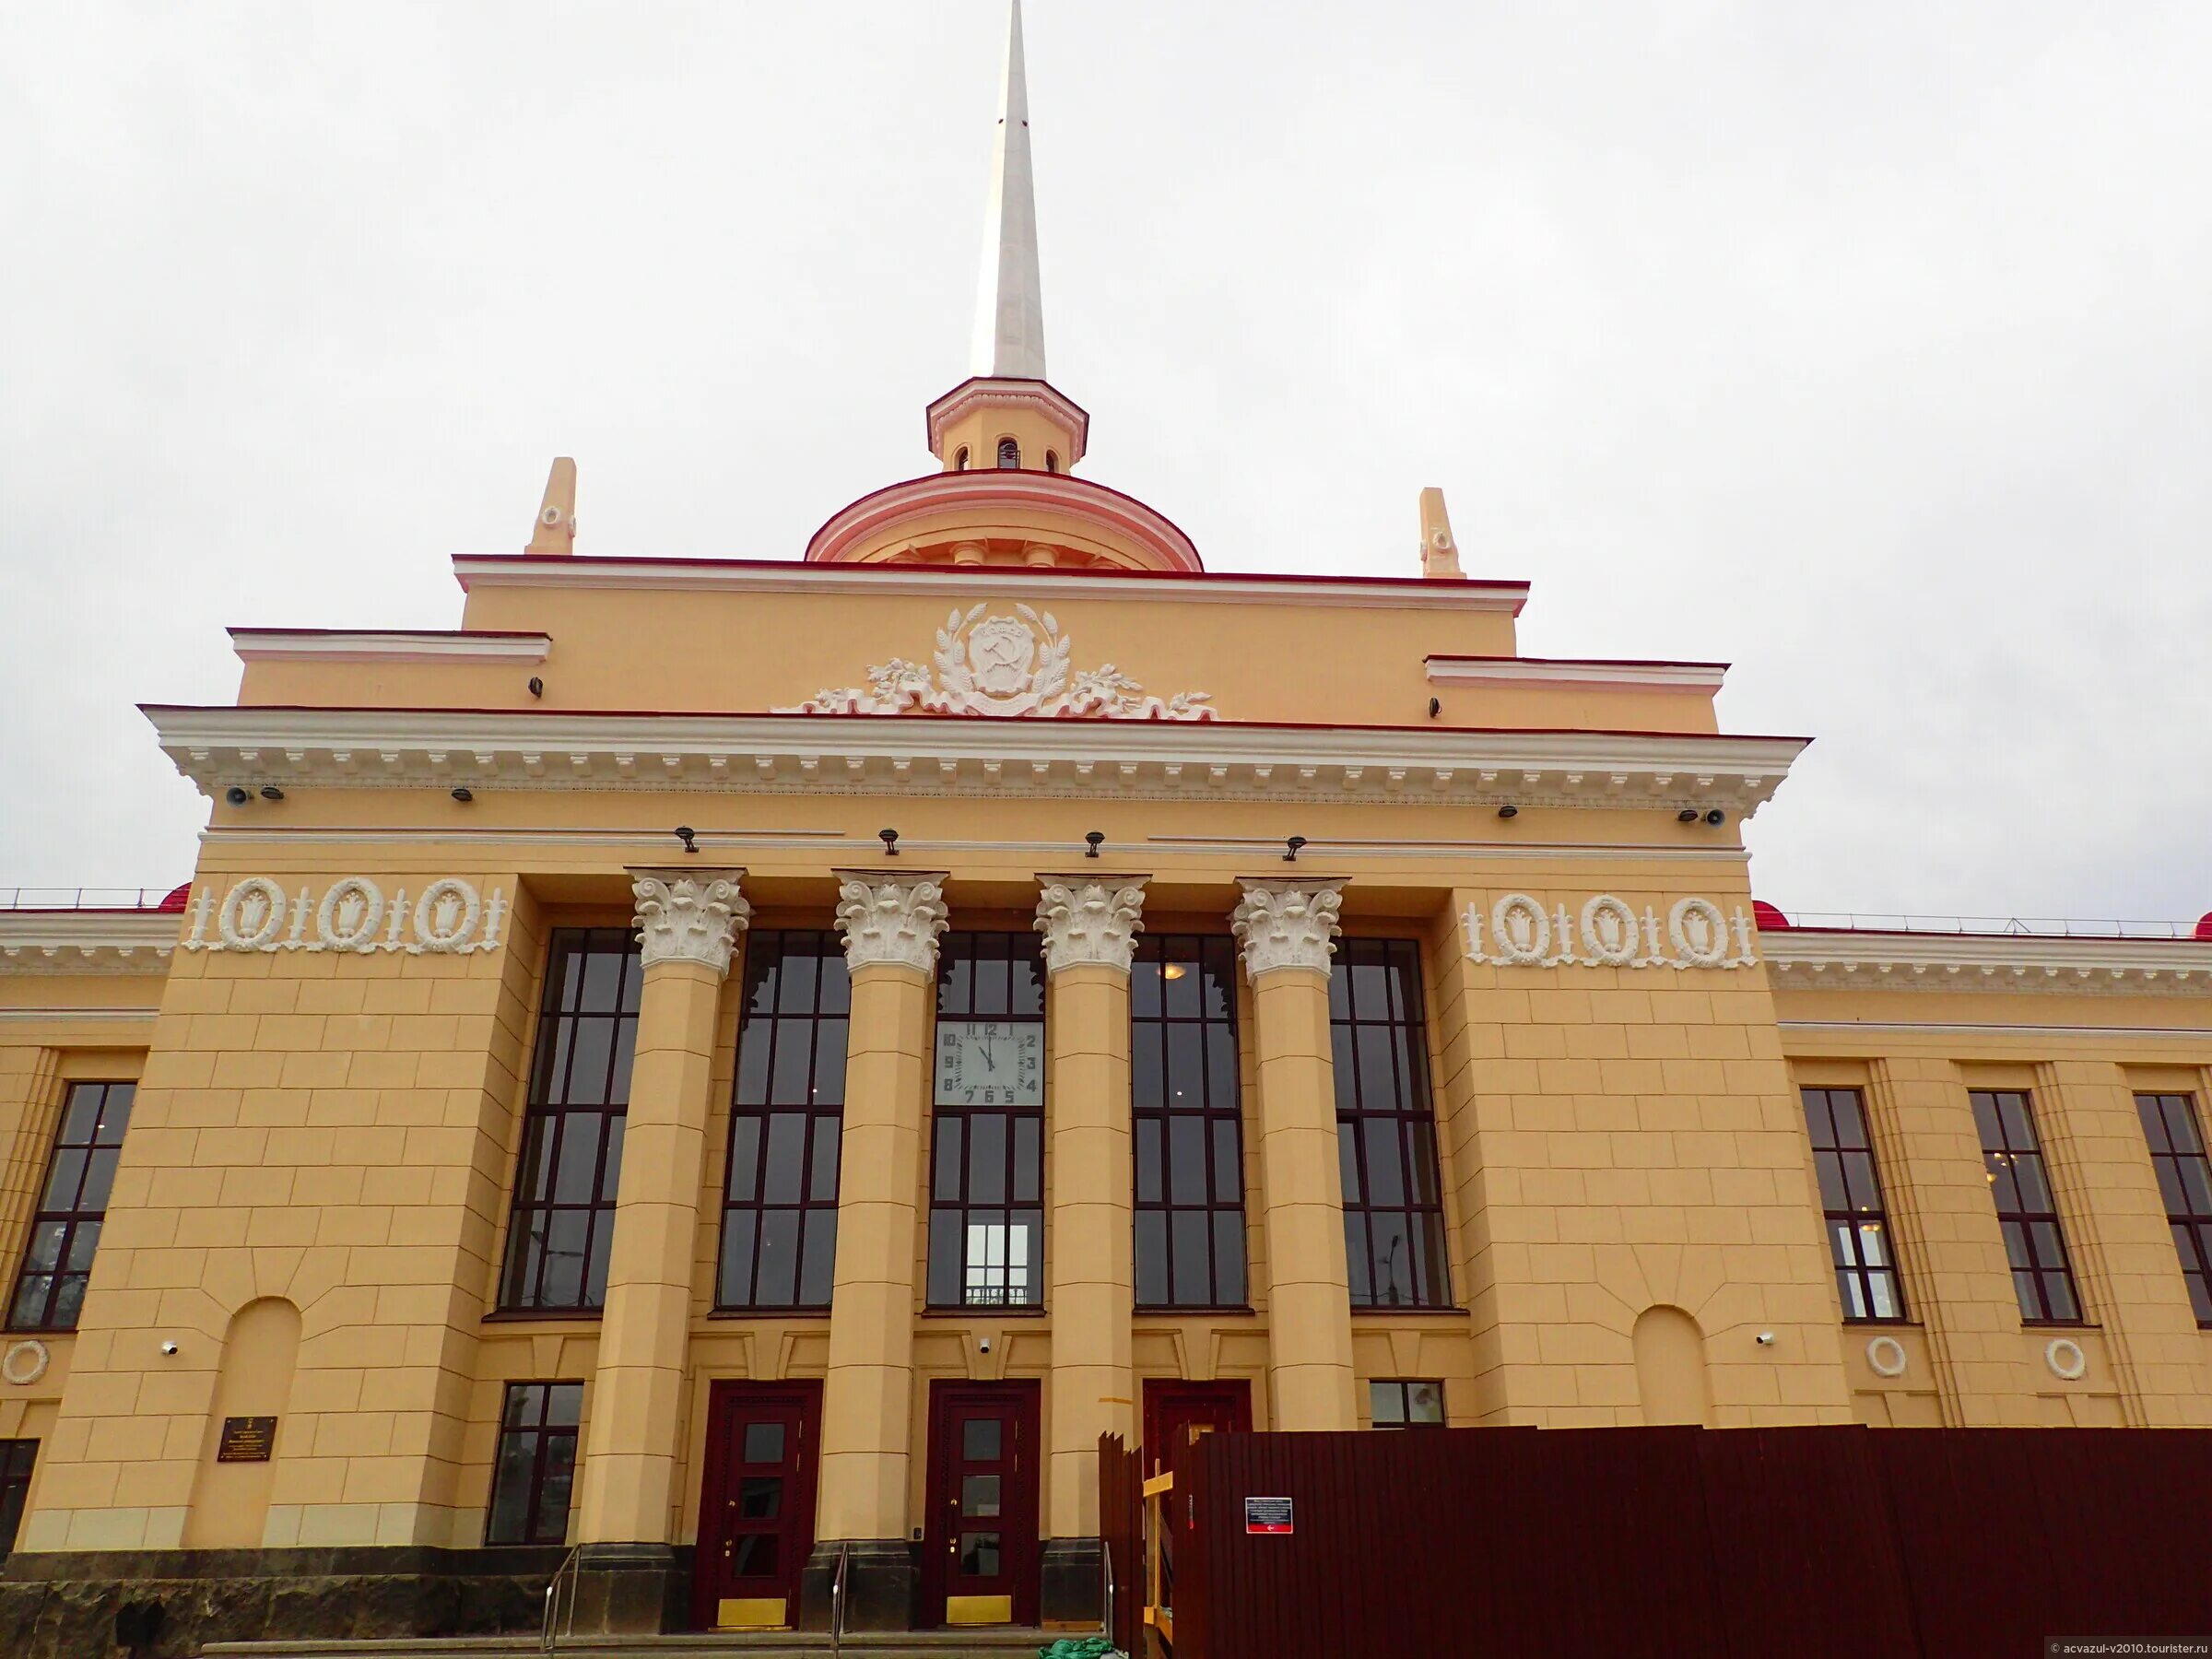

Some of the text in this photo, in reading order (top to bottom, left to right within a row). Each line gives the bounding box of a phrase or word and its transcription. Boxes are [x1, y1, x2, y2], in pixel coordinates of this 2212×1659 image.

[967, 1024, 975, 1035] 11
[984, 1024, 996, 1035] 12
[944, 1034, 956, 1046] 10
[1027, 1035, 1035, 1047] 2
[945, 1055, 954, 1068] 9
[1027, 1057, 1036, 1069] 3
[944, 1078, 953, 1091] 8
[1027, 1079, 1036, 1092] 4
[965, 1090, 974, 1103] 7
[985, 1090, 994, 1103] 6
[1006, 1091, 1014, 1103] 5
